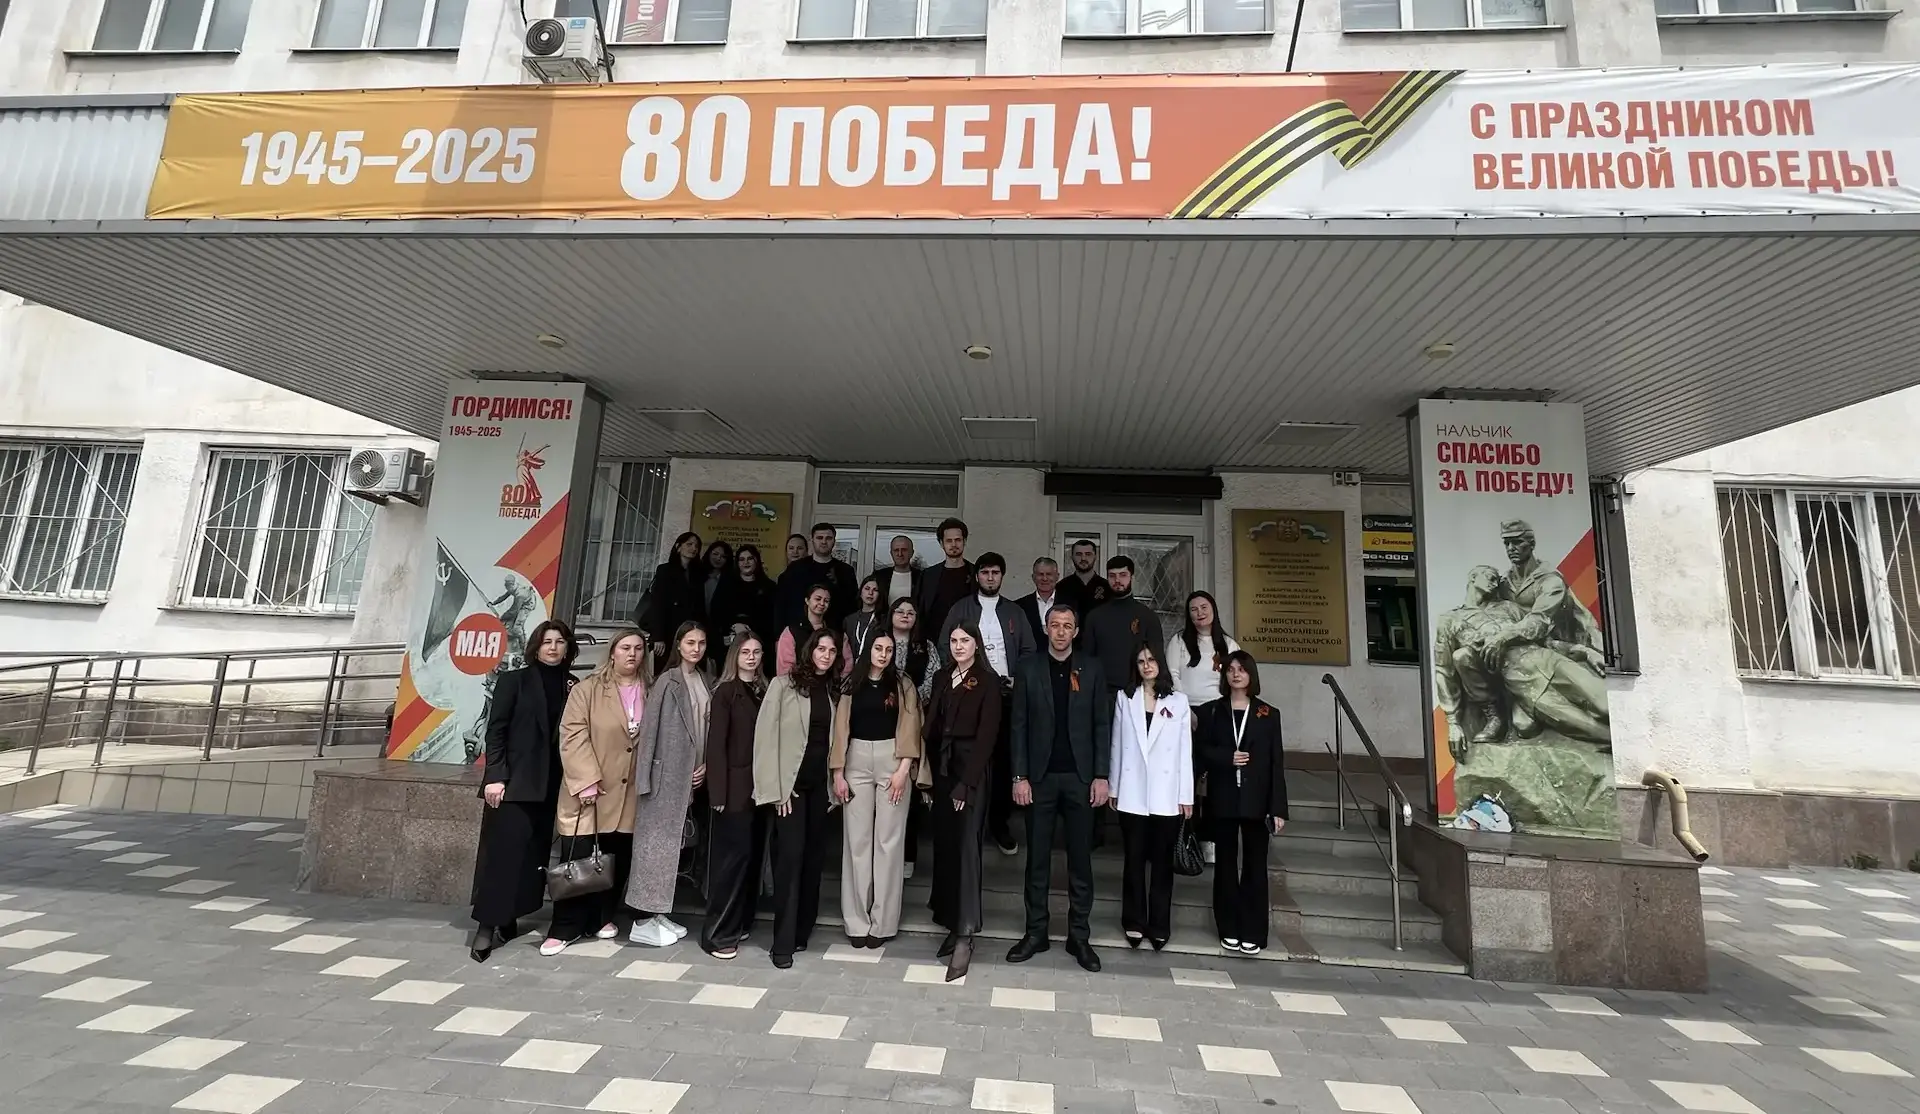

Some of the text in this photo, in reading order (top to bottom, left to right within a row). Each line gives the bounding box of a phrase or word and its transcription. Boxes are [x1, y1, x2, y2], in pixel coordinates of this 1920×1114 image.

[1469, 98, 1815, 144] С ПРАЗДНИКОМ
[240, 127, 538, 186] 1945–2025
[620, 94, 1153, 201] 80 ПОБЕДА!
[1472, 147, 1900, 194] ВЕЛИКОЙ ПОБЕДЫ!
[451, 395, 573, 421] ГОРДИМСЯ!
[1436, 423, 1513, 438] НАЛЬЧИК
[1437, 441, 1542, 466] СПАСИБО
[501, 483, 525, 504] 80
[1438, 469, 1574, 498] ЗА ПОБЕДУ!
[498, 507, 541, 520] ПОБЕДА!
[1256, 627, 1330, 635] ЗДРАВООХРАНЕНИЯ
[1261, 617, 1323, 626] МИНИСТЕРСТВО
[455, 629, 502, 659] МАЯ
[1266, 645, 1318, 654] РЕСПУБЛИКИ
